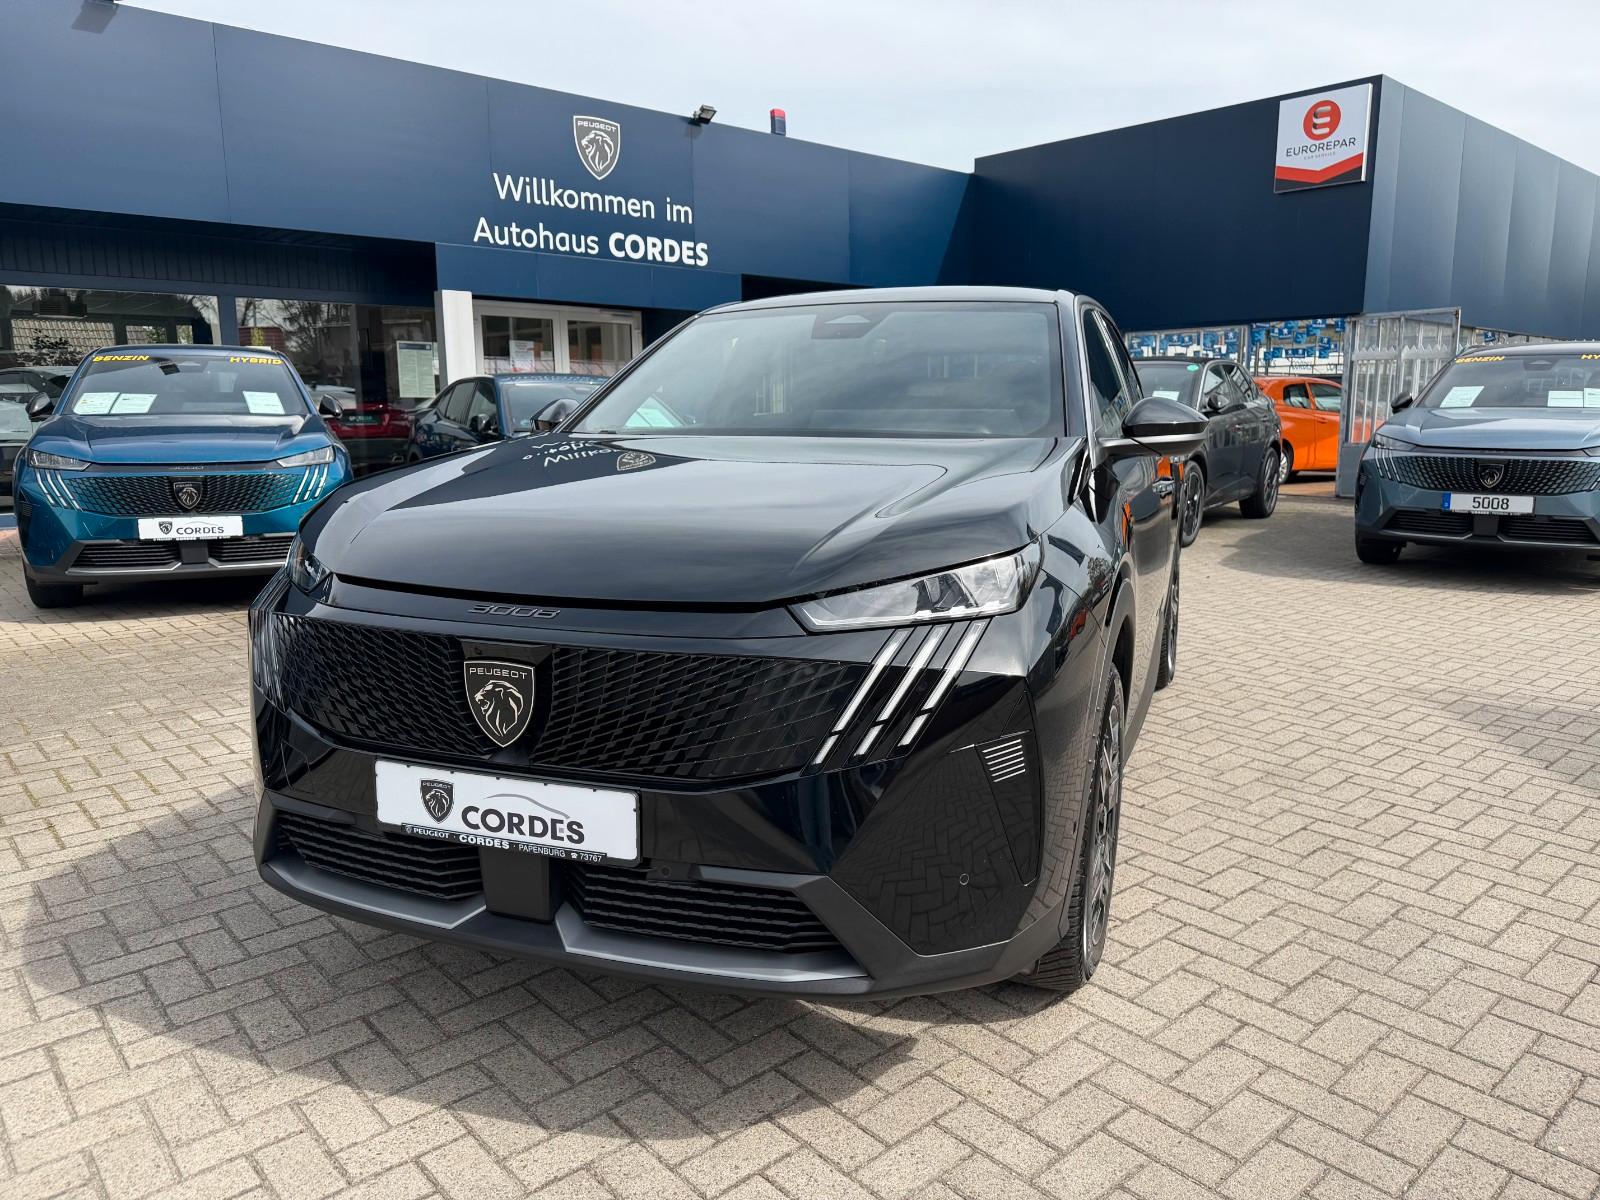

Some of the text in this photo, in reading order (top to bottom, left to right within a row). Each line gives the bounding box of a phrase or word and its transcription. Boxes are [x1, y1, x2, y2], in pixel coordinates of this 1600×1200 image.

[577, 120, 617, 133] PEUGEOT
[1286, 137, 1357, 157] EUROREPAR
[493, 172, 693, 224] Willkommen im
[473, 216, 709, 267] Autohaus CORDES
[229, 356, 282, 365] HYBRID
[1472, 496, 1510, 510] 5008
[176, 526, 225, 535] CORDES
[469, 667, 528, 680] PEUGEOT
[422, 781, 452, 790] PEUGEOT
[461, 805, 585, 845] CORDES
[413, 827, 602, 862] PEUGEOT CORDES PAPENBURG 73767
